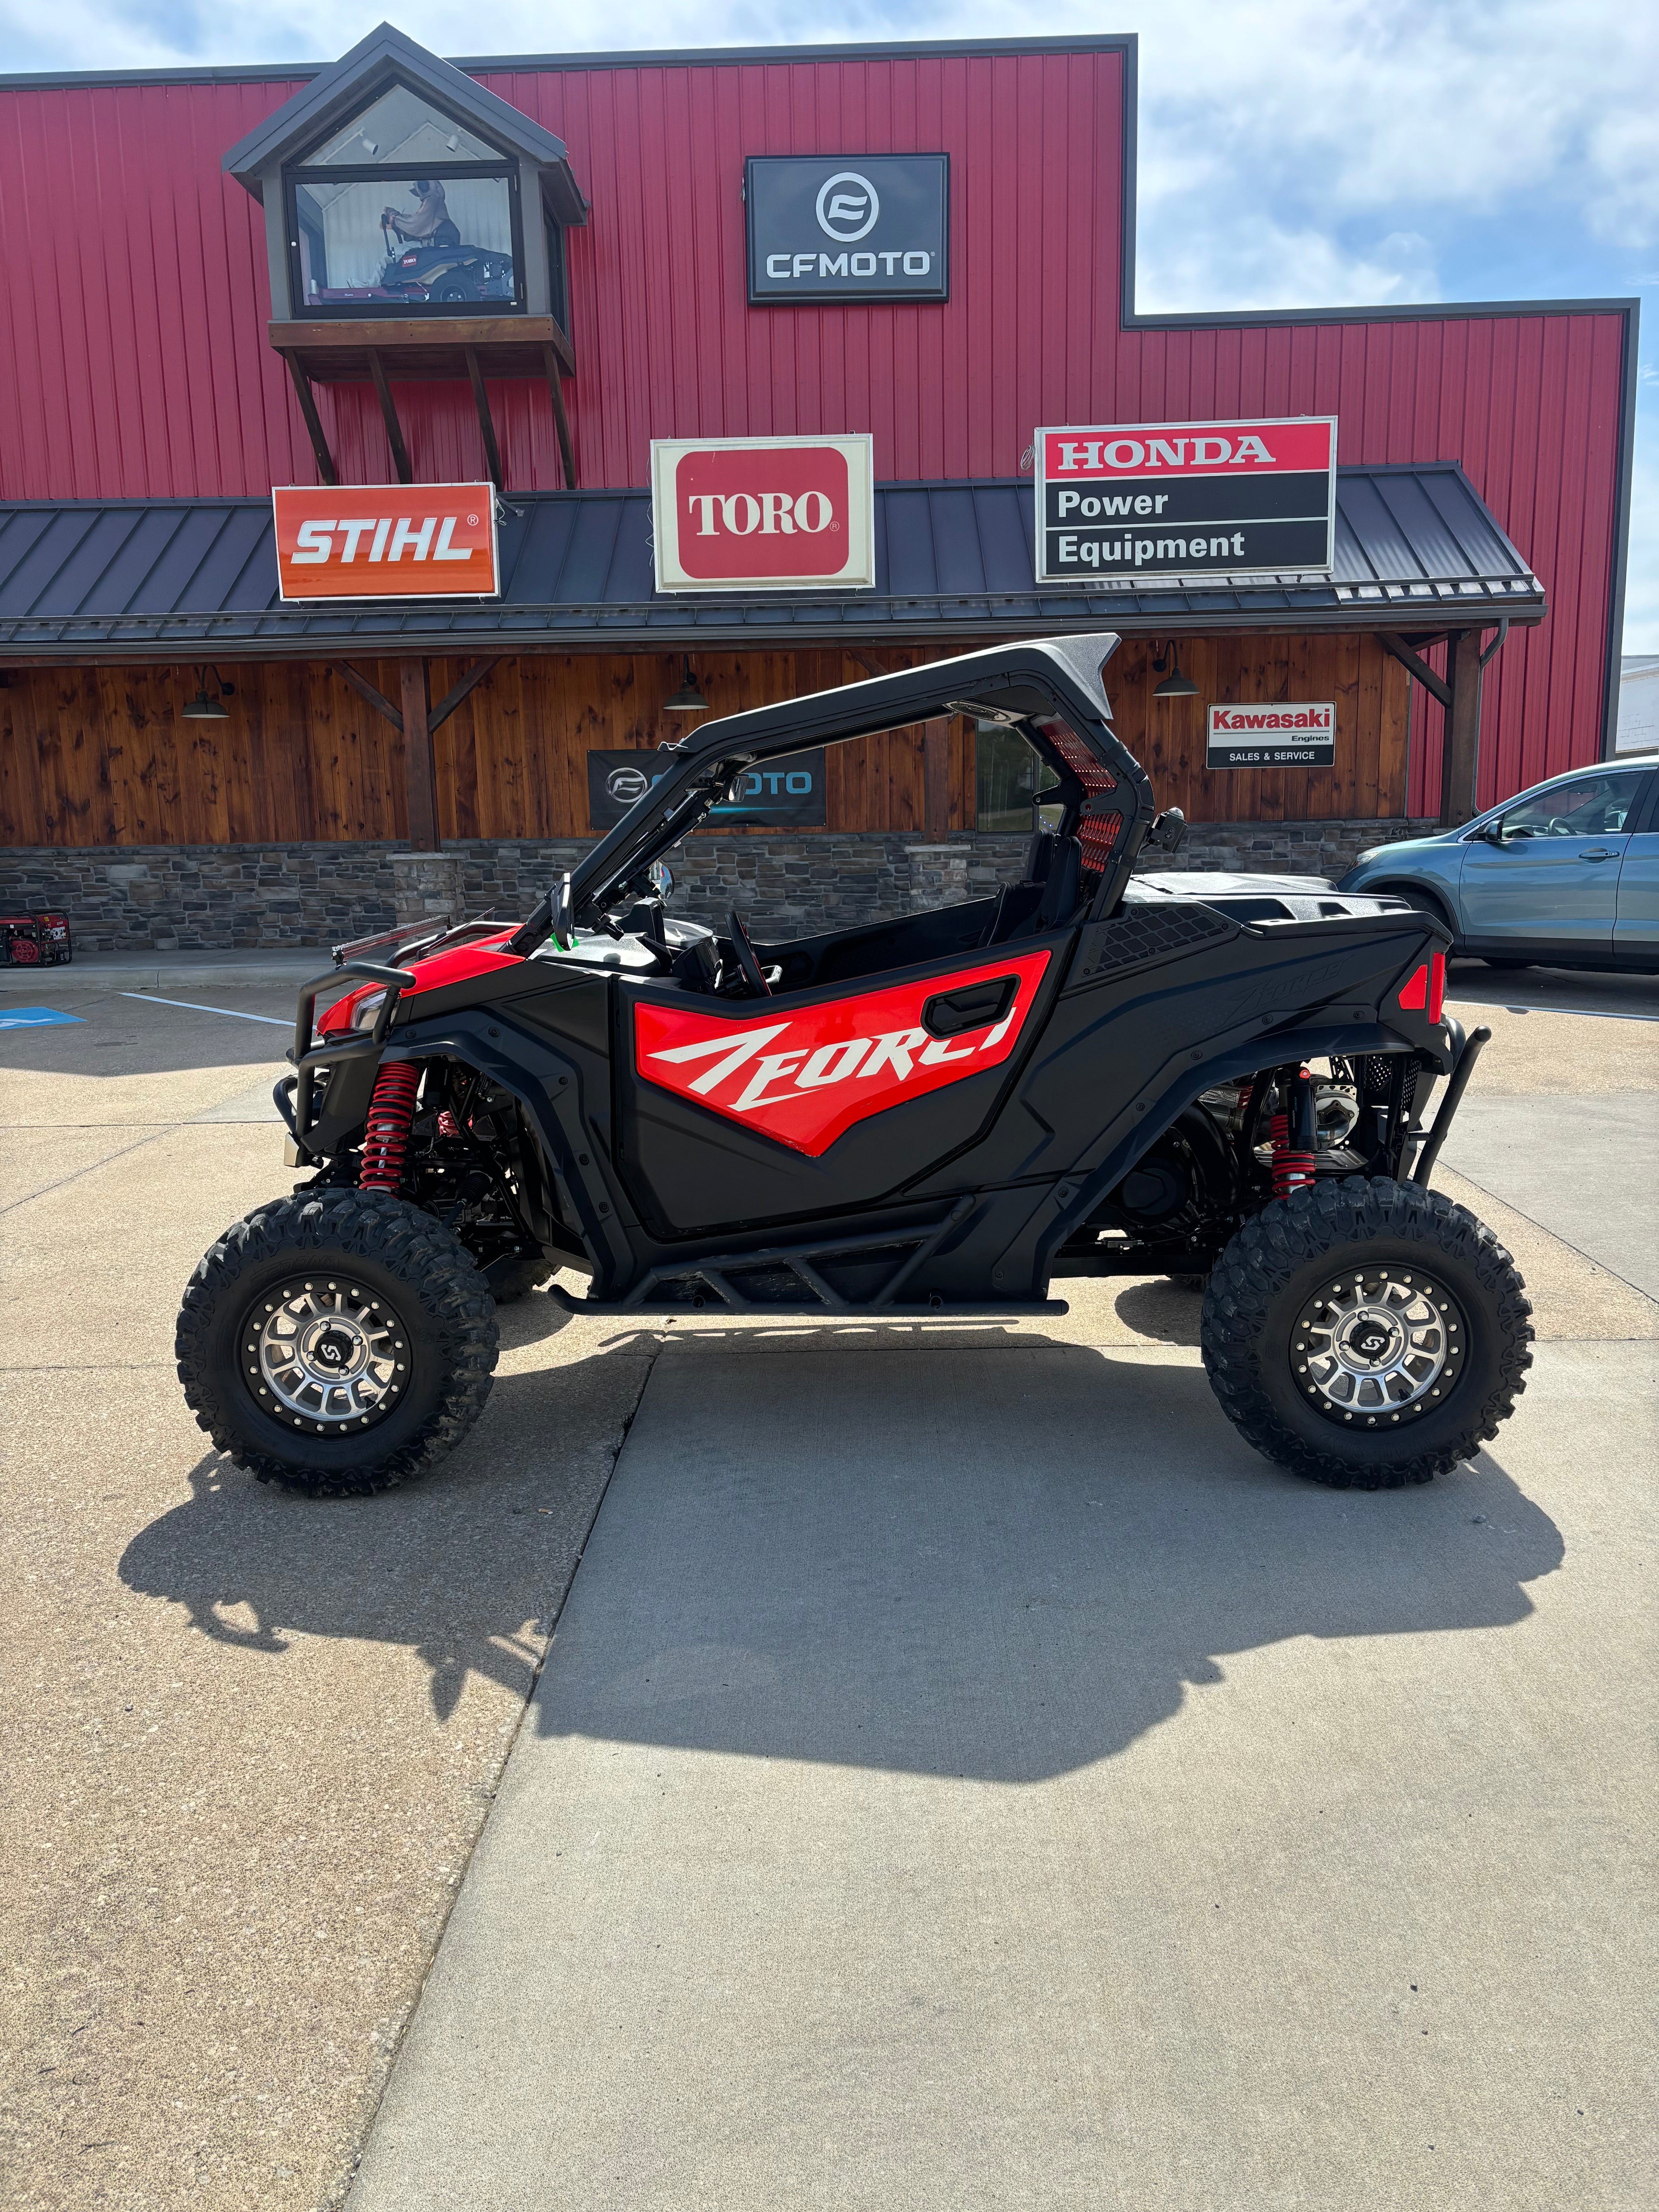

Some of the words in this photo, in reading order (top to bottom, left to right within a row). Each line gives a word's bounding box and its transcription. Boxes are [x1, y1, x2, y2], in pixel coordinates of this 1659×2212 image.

[766, 251, 930, 278] CFMOTO
[1058, 436, 1276, 471] HONDA
[689, 491, 833, 535] TORO
[1058, 491, 1168, 518] Power
[290, 517, 473, 564] STIHL
[1058, 532, 1245, 568] Equipment
[1213, 708, 1330, 730] Kawasaki
[1229, 752, 1260, 761] SALES
[1274, 751, 1315, 760] SERVICE
